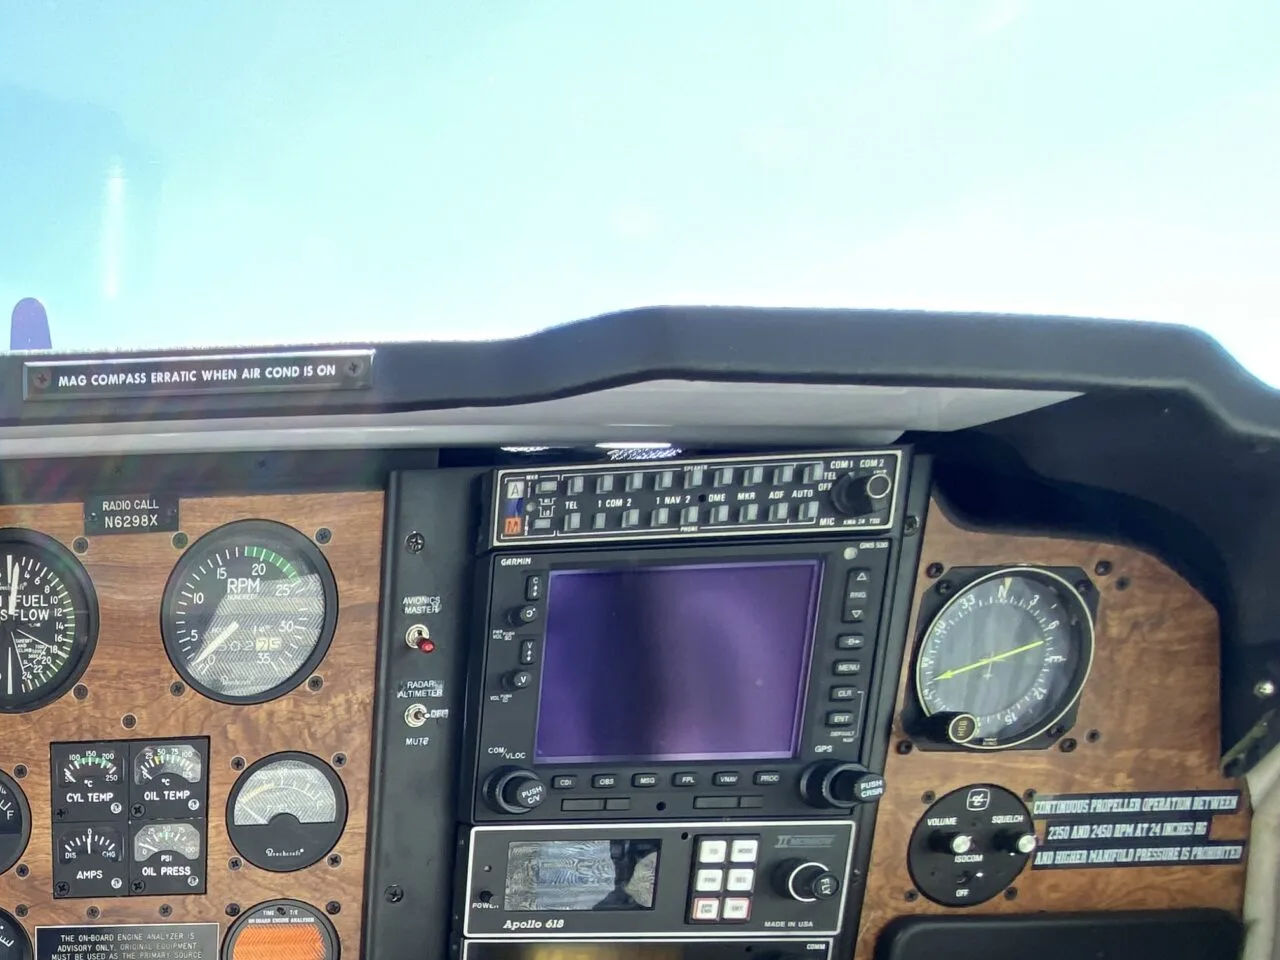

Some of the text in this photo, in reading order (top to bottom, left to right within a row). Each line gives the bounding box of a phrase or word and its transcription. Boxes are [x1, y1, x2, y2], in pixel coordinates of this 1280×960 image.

[58, 364, 336, 387] MAG COMPASS ERRATIC WHEN AIR COND IS ON
[709, 490, 813, 502] DME AUTO
[103, 499, 159, 511] RADIO CALL
[105, 515, 158, 528] N6298X
[501, 557, 531, 566] GARMIN
[252, 564, 266, 575] 20
[227, 578, 260, 593] RPM
[16, 595, 48, 606] FUEL
[560, 778, 614, 786] CDI OBS
[861, 780, 883, 789] PUSH
[144, 791, 190, 801] OIL TEMP
[522, 787, 542, 797] PUSH
[66, 793, 113, 802] CYL TEMP
[1034, 796, 1238, 814] CONTINUOUS PROPELLER OPERATION BETWEEN
[927, 817, 958, 826] VOLUME
[992, 815, 1023, 824] SQUELCH
[1048, 822, 1208, 840] 2350 AND 2450 AT INCHES HG
[1034, 846, 1242, 865] AND HIGHER MANIFOLD PRESSURE IS PROHIBITED
[76, 870, 103, 879] AMPS
[142, 867, 191, 876] OIL PRESS
[503, 920, 564, 930] Apollo 618
[60, 932, 184, 942] THE ON-BOARD ENGINE ANALYZER
[57, 944, 92, 952] ADVISORY
[87, 952, 106, 960] USED
[109, 952, 119, 960] AS
